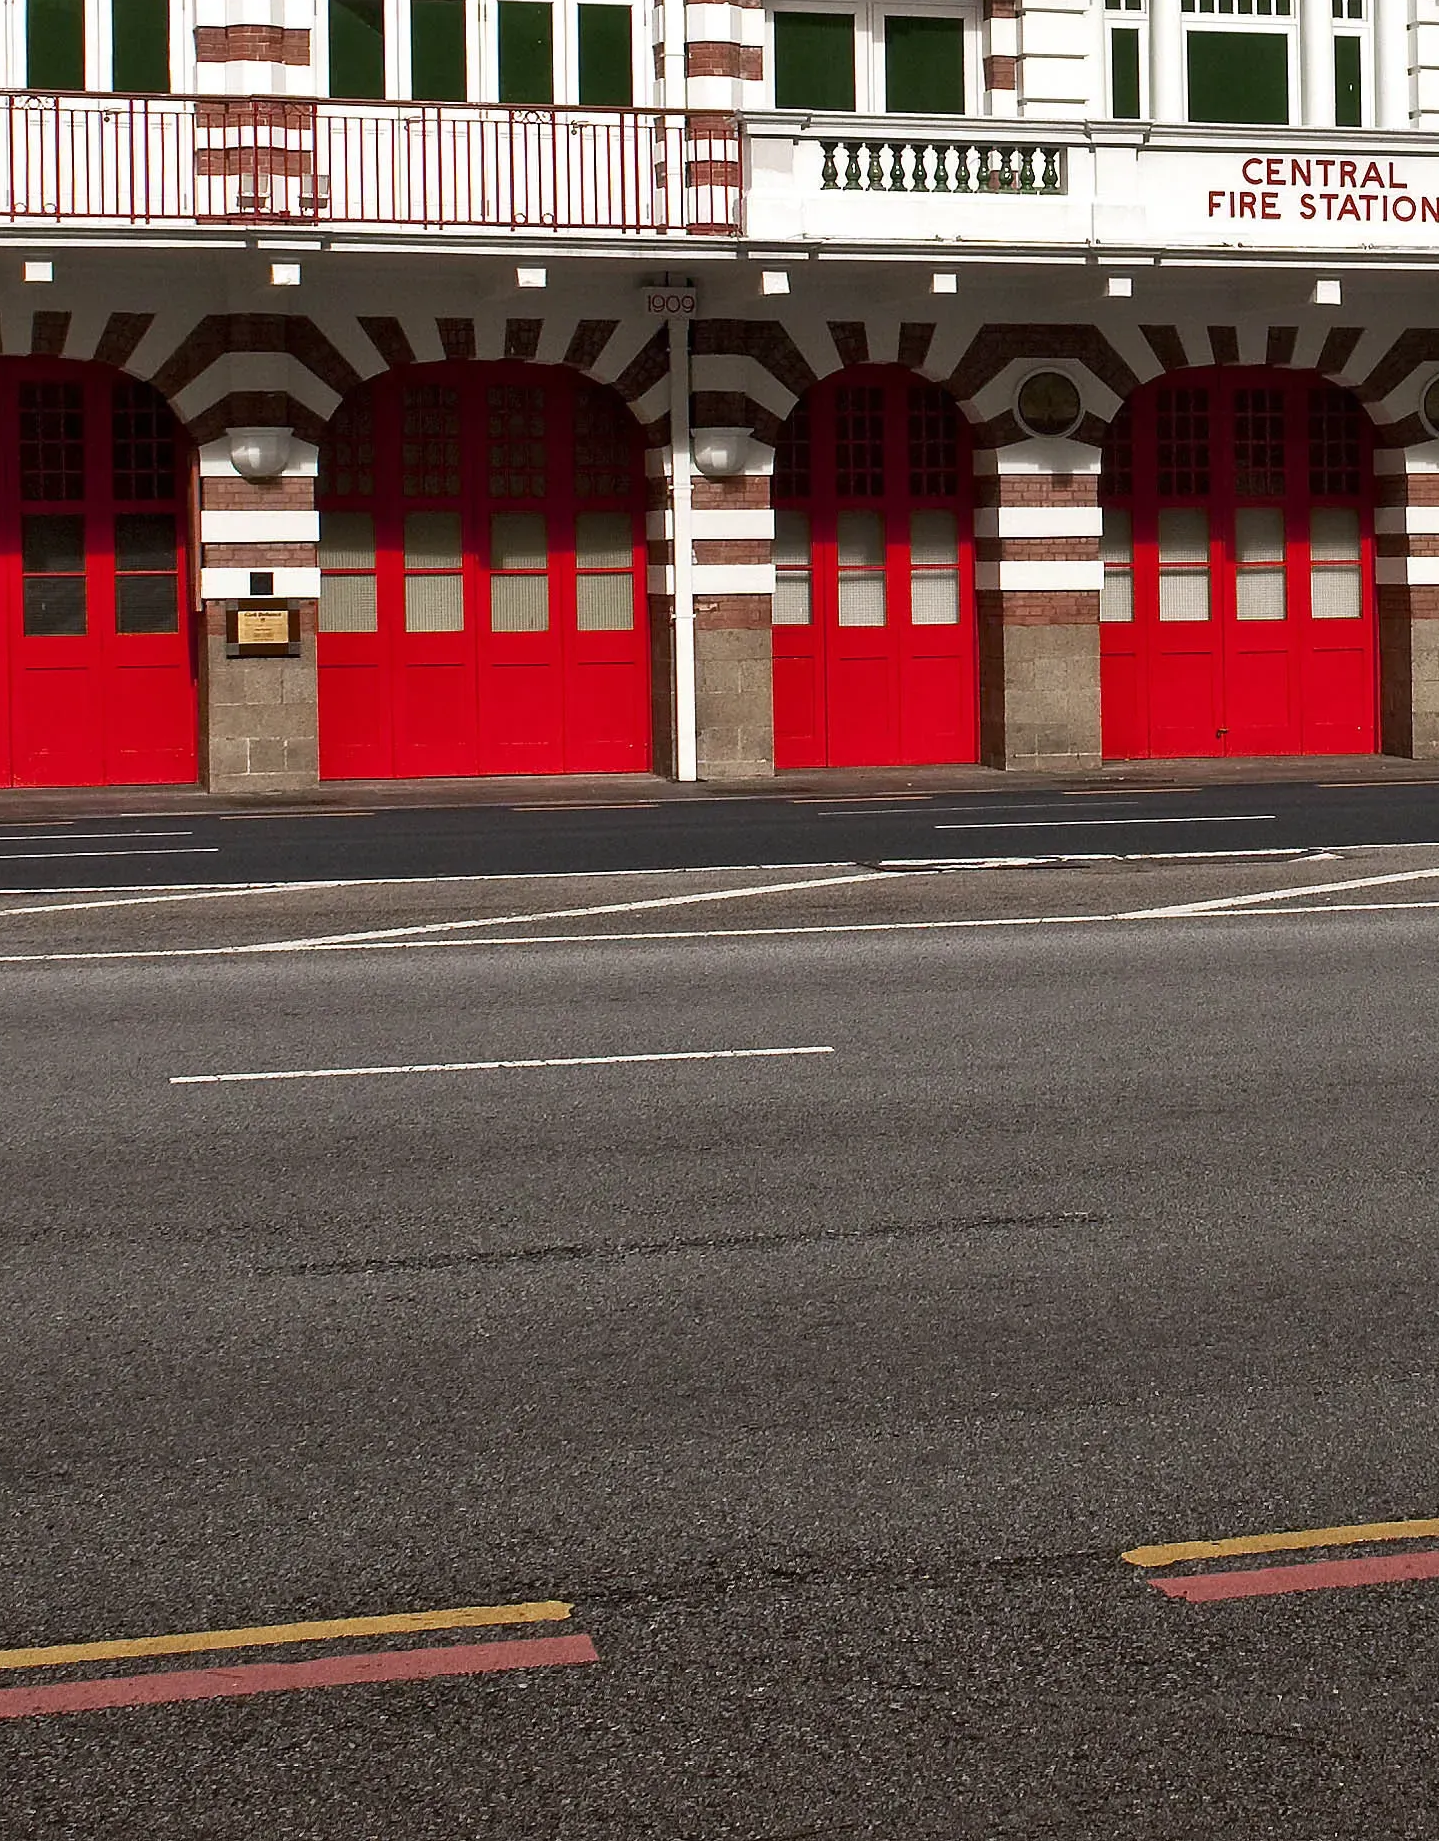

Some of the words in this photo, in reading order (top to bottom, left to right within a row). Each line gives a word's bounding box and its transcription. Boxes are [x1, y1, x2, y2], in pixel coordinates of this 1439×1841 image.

[1242, 158, 1408, 189] CENTRAL
[1208, 191, 1282, 220] FIRE
[647, 294, 695, 313] 1909
